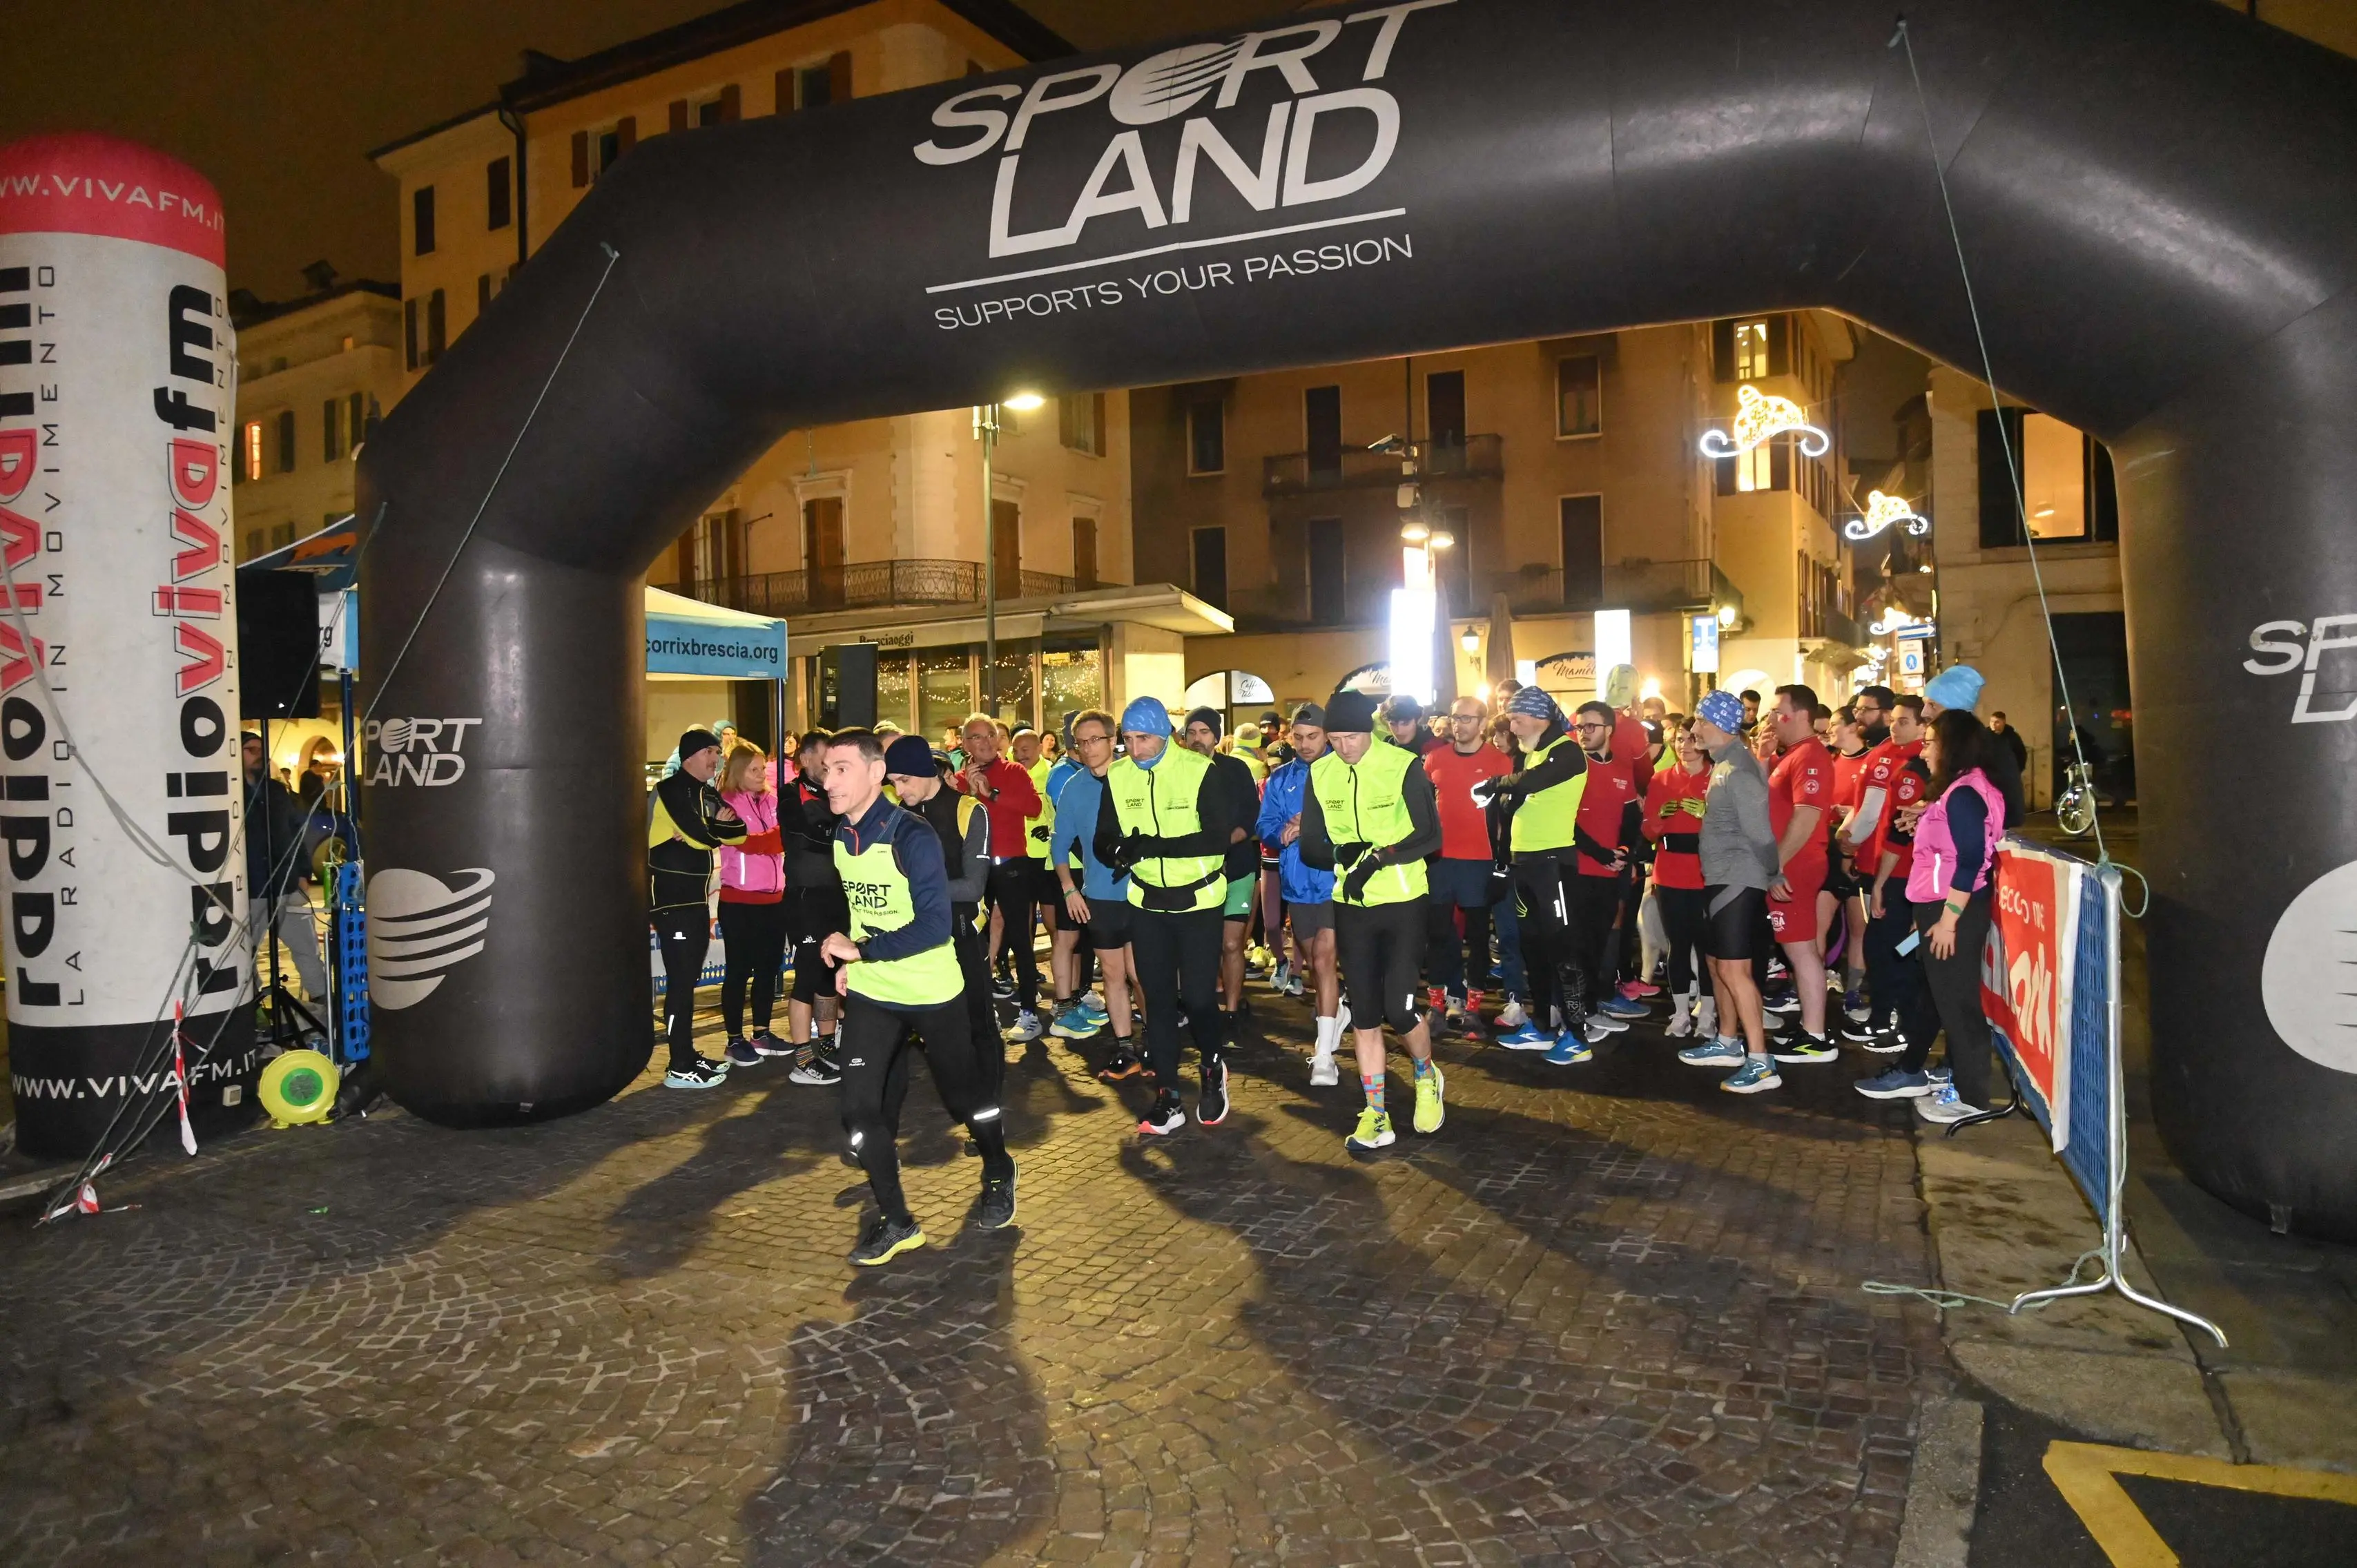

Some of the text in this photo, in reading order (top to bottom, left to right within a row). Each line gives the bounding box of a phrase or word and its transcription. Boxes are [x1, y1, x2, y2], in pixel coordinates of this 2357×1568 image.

[913, 0, 1458, 166] SPORT
[989, 87, 1401, 259] LAND
[934, 233, 1413, 331] SUPPORTS YOUR PASSION
[38, 266, 84, 1006] LA RADIO IN MOVIMENTO
[859, 630, 914, 647] Bsciaoggi
[364, 717, 483, 753] PORT
[363, 753, 465, 786] LAND
[841, 880, 892, 897] SPORT
